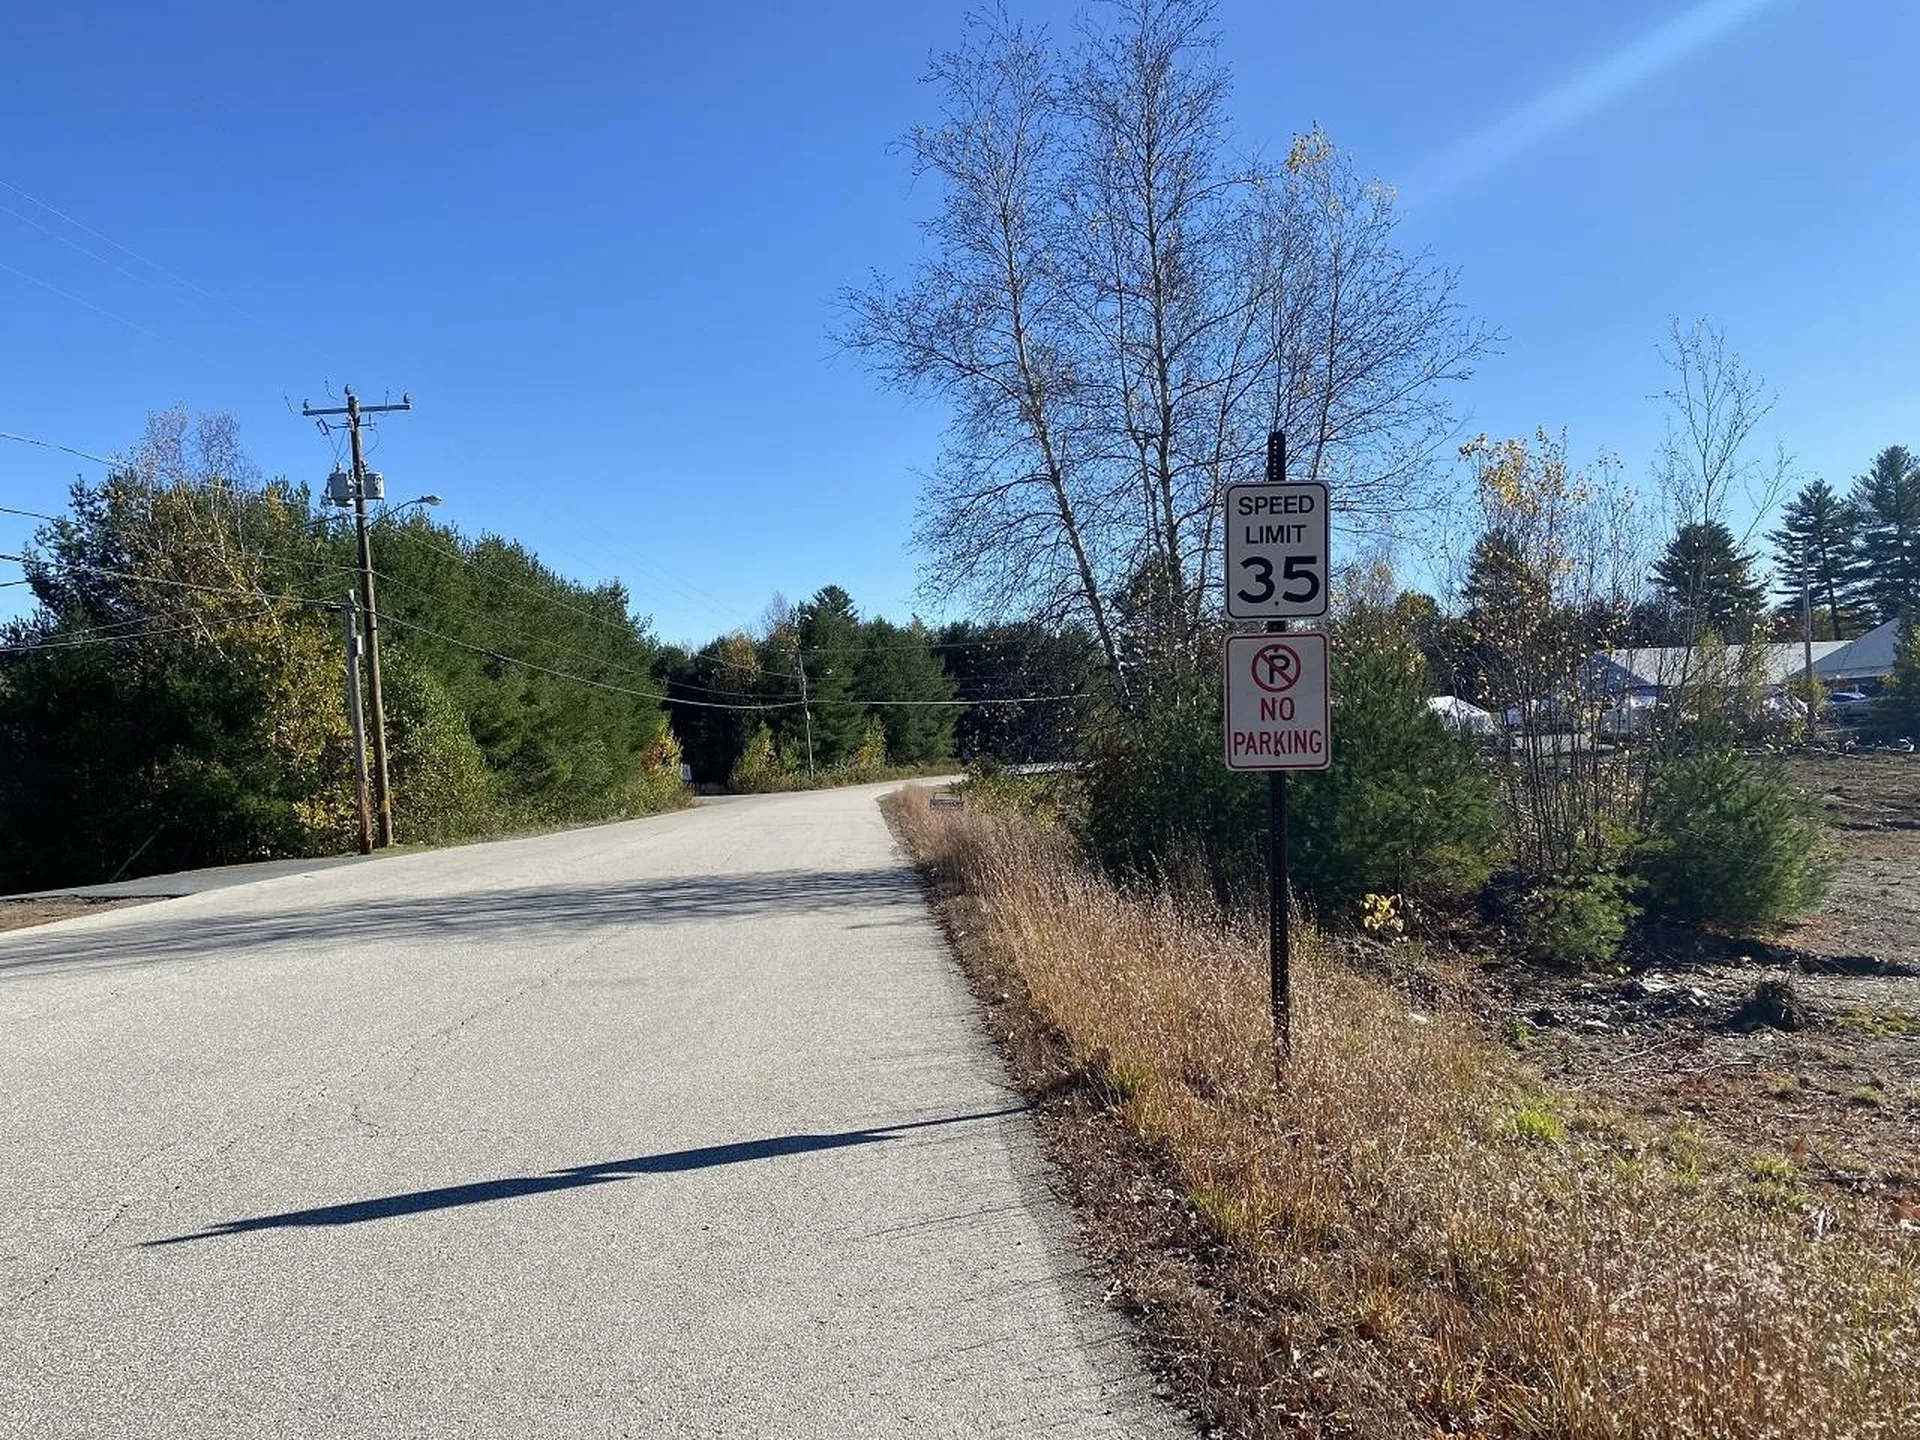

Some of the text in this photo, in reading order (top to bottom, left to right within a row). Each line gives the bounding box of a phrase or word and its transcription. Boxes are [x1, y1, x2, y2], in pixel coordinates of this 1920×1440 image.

[1238, 495, 1314, 516] SPEED
[1245, 524, 1307, 544] LIMIT
[1237, 556, 1320, 603] 35
[1260, 697, 1294, 721] NO
[1233, 730, 1322, 756] PARKING
